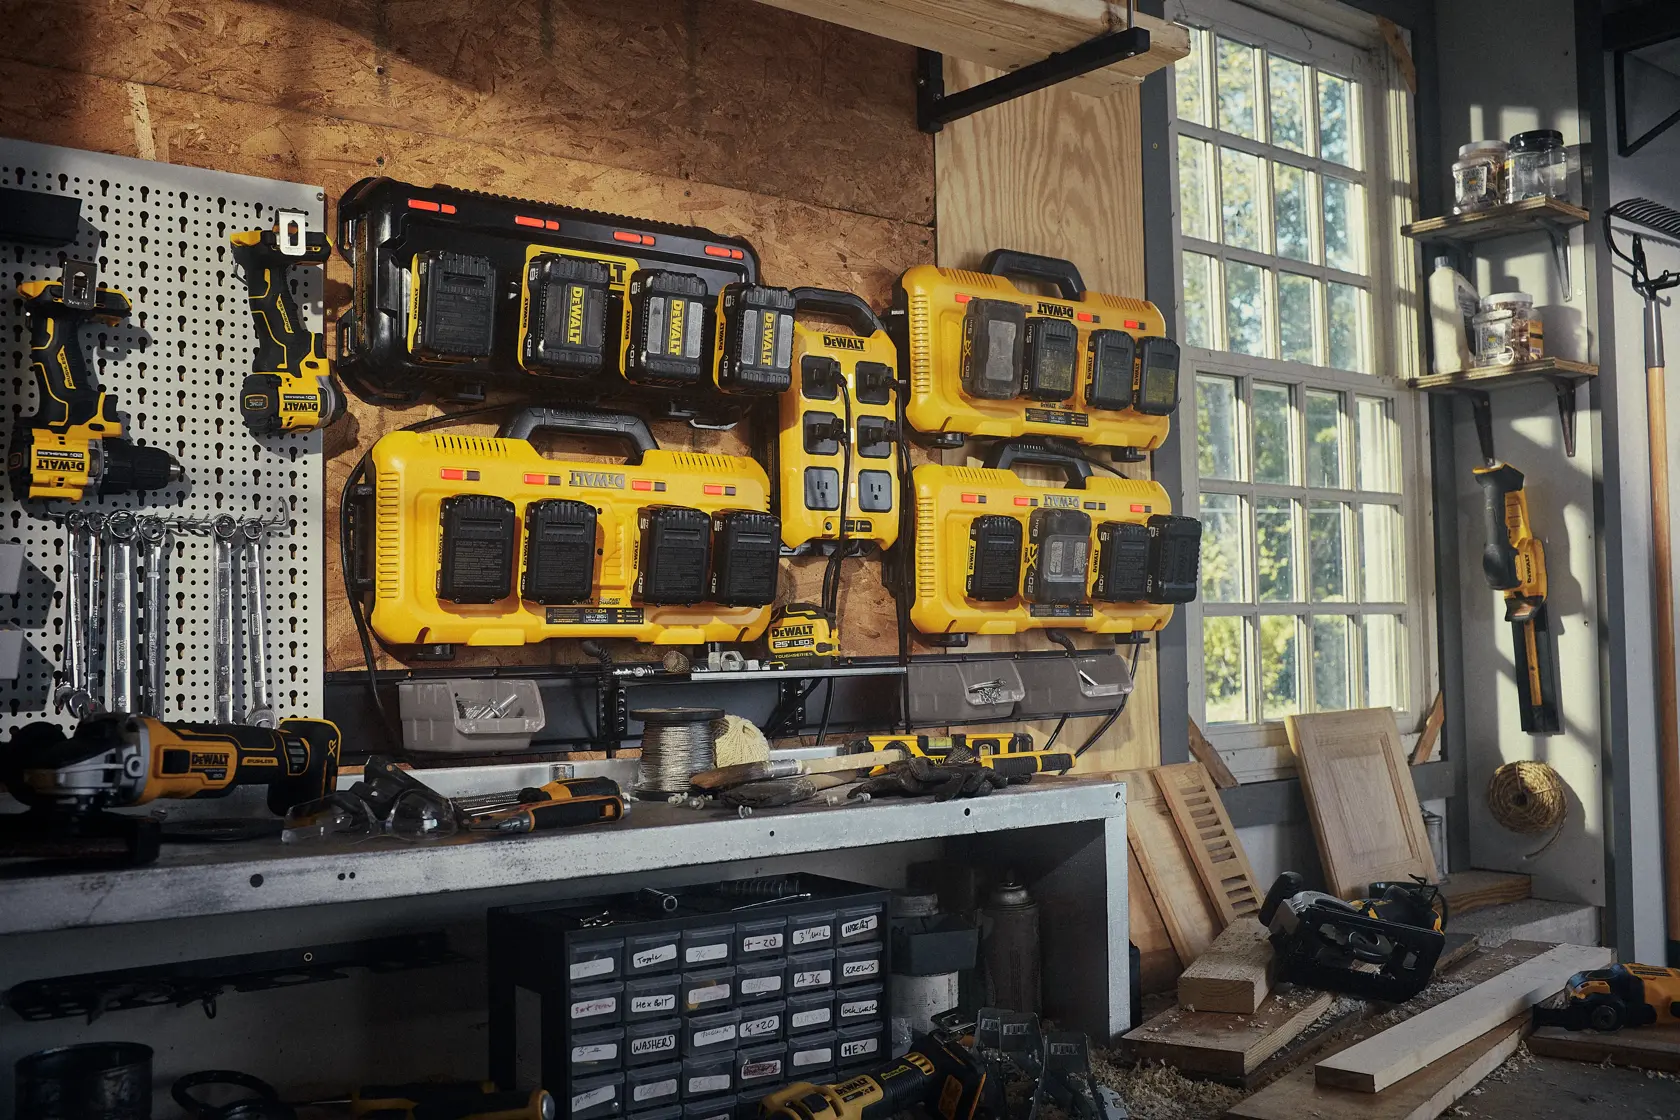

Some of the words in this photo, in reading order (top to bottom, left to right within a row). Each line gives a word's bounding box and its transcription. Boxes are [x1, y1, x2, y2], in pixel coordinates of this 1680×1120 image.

[570, 286, 583, 345] DEWALT
[1038, 302, 1074, 318] DEWALT
[671, 300, 683, 355] DEWALT
[762, 312, 775, 366] DEWALT
[824, 335, 865, 350] DEWALT
[964, 340, 972, 356] XR
[283, 401, 318, 412] DEWALT
[36, 459, 85, 472] DEWALT
[569, 471, 625, 489] DEWALT
[1043, 495, 1079, 508] DEWALT
[1026, 543, 1038, 570] XR
[1027, 571, 1035, 594] 20V
[772, 625, 814, 638] DEWALT
[327, 738, 337, 759] XR
[192, 753, 229, 766] DEWALT
[632, 1034, 675, 1052] WASHERS
[844, 1042, 868, 1056] HEX
